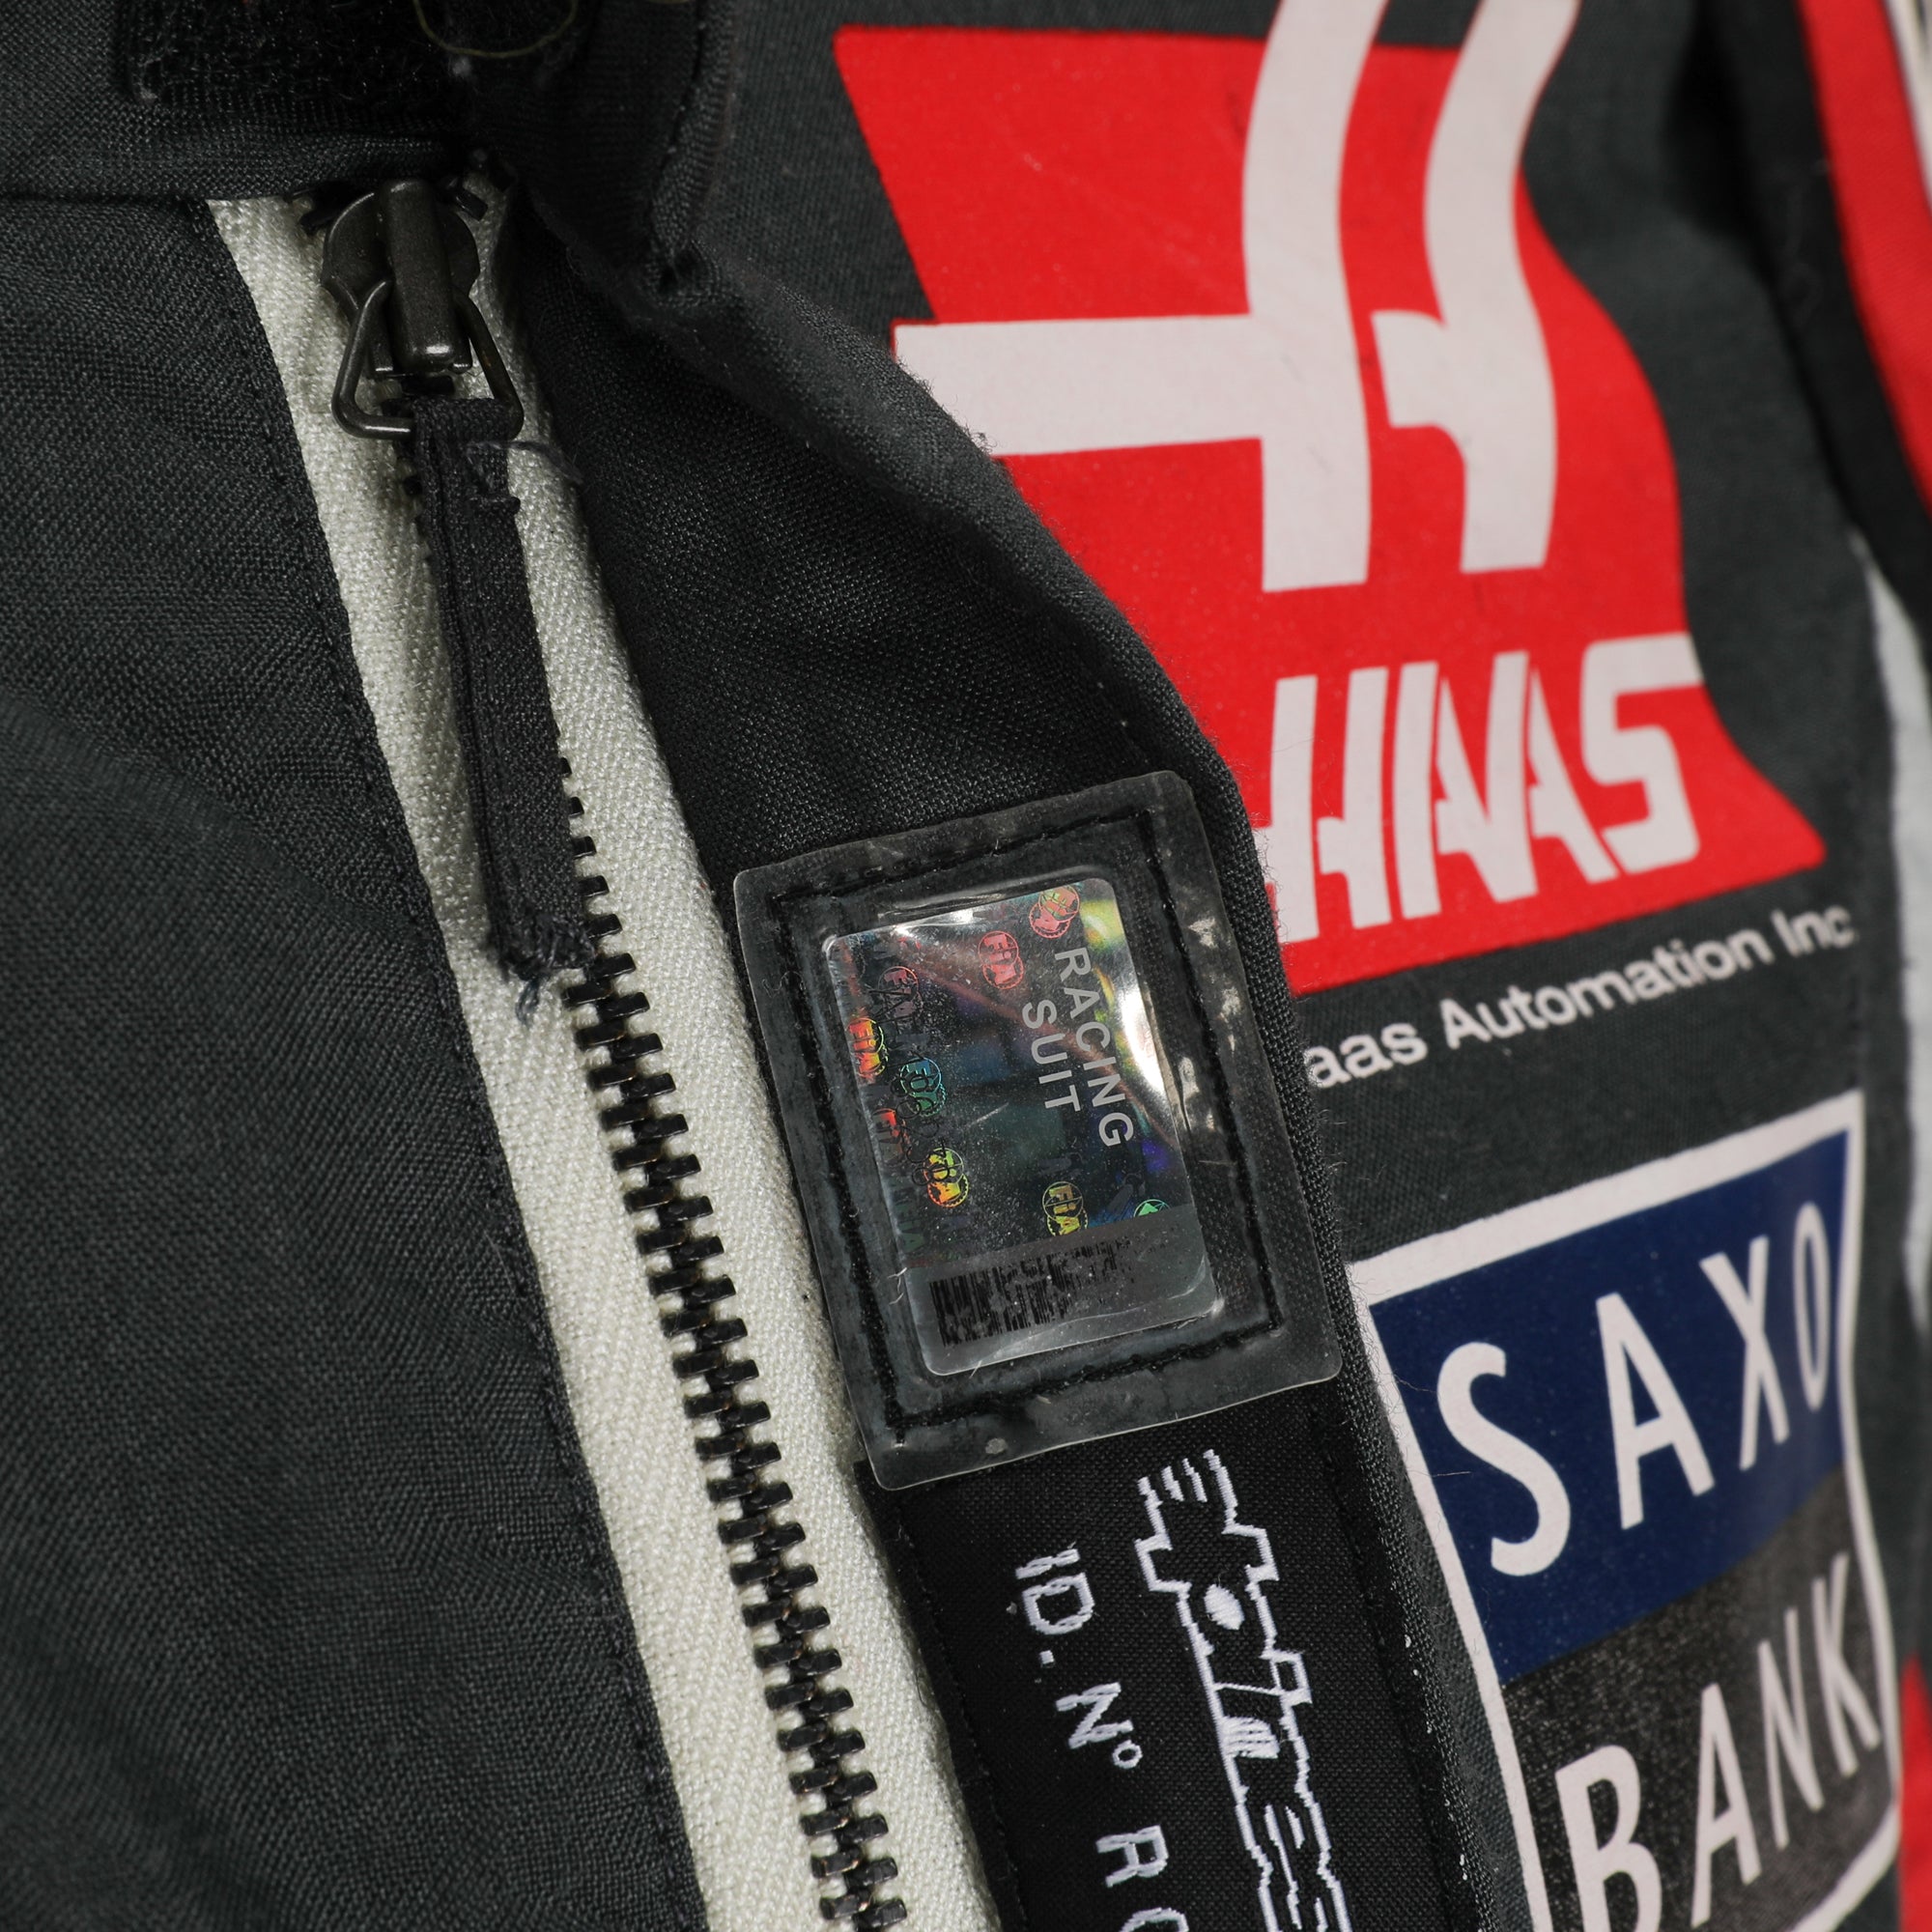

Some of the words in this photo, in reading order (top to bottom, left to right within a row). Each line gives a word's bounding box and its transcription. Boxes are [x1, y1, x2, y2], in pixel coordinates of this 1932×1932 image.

[1254, 633, 1706, 944] HAAS
[1021, 999, 1082, 1112] SUIT
[1054, 947, 1134, 1148] RACING
[1304, 1022, 1428, 1089] aas
[1439, 927, 1776, 1050] Automation
[1435, 1203, 1831, 1577] SAXO
[1014, 1548, 1095, 1665] ID.
[1553, 1551, 1883, 1932] BANK
